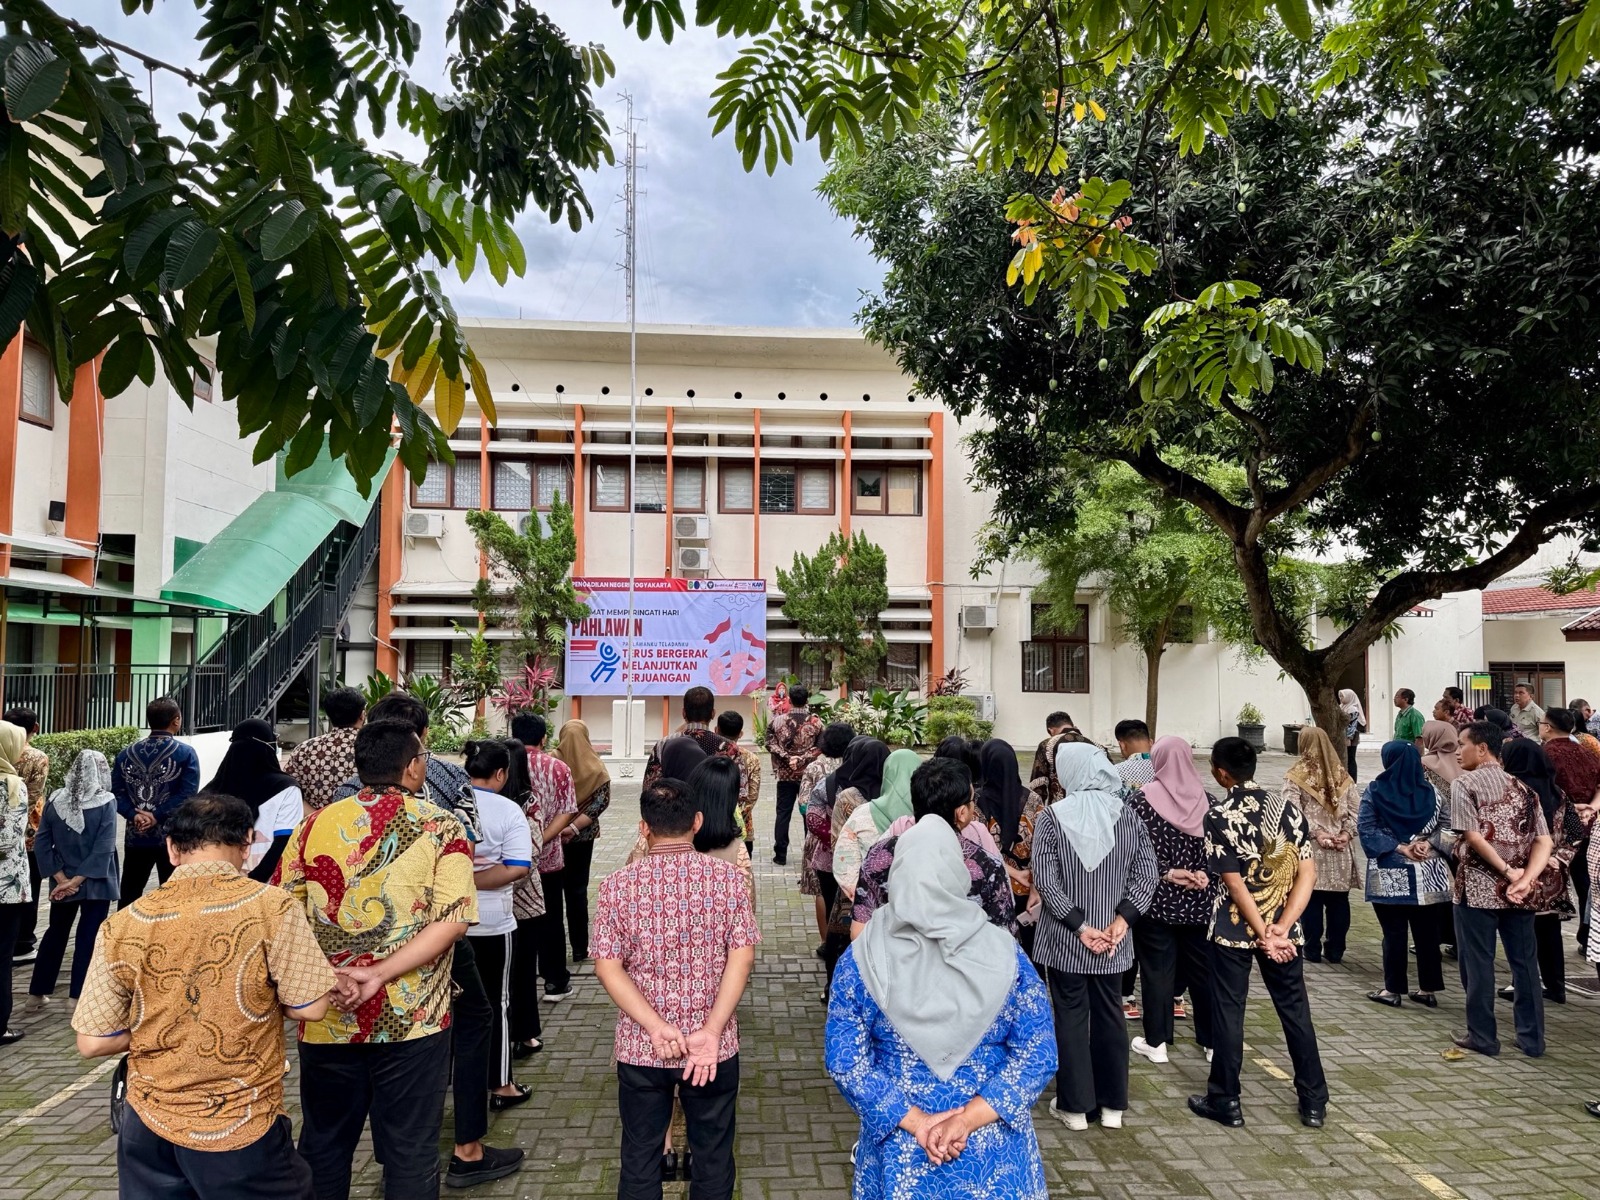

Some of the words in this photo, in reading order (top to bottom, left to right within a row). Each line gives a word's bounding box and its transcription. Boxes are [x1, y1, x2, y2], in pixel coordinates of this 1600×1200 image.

[622, 649, 654, 658] TRUS
[656, 649, 709, 659] BERGERAK
[622, 673, 691, 682] PRJUANGAN
